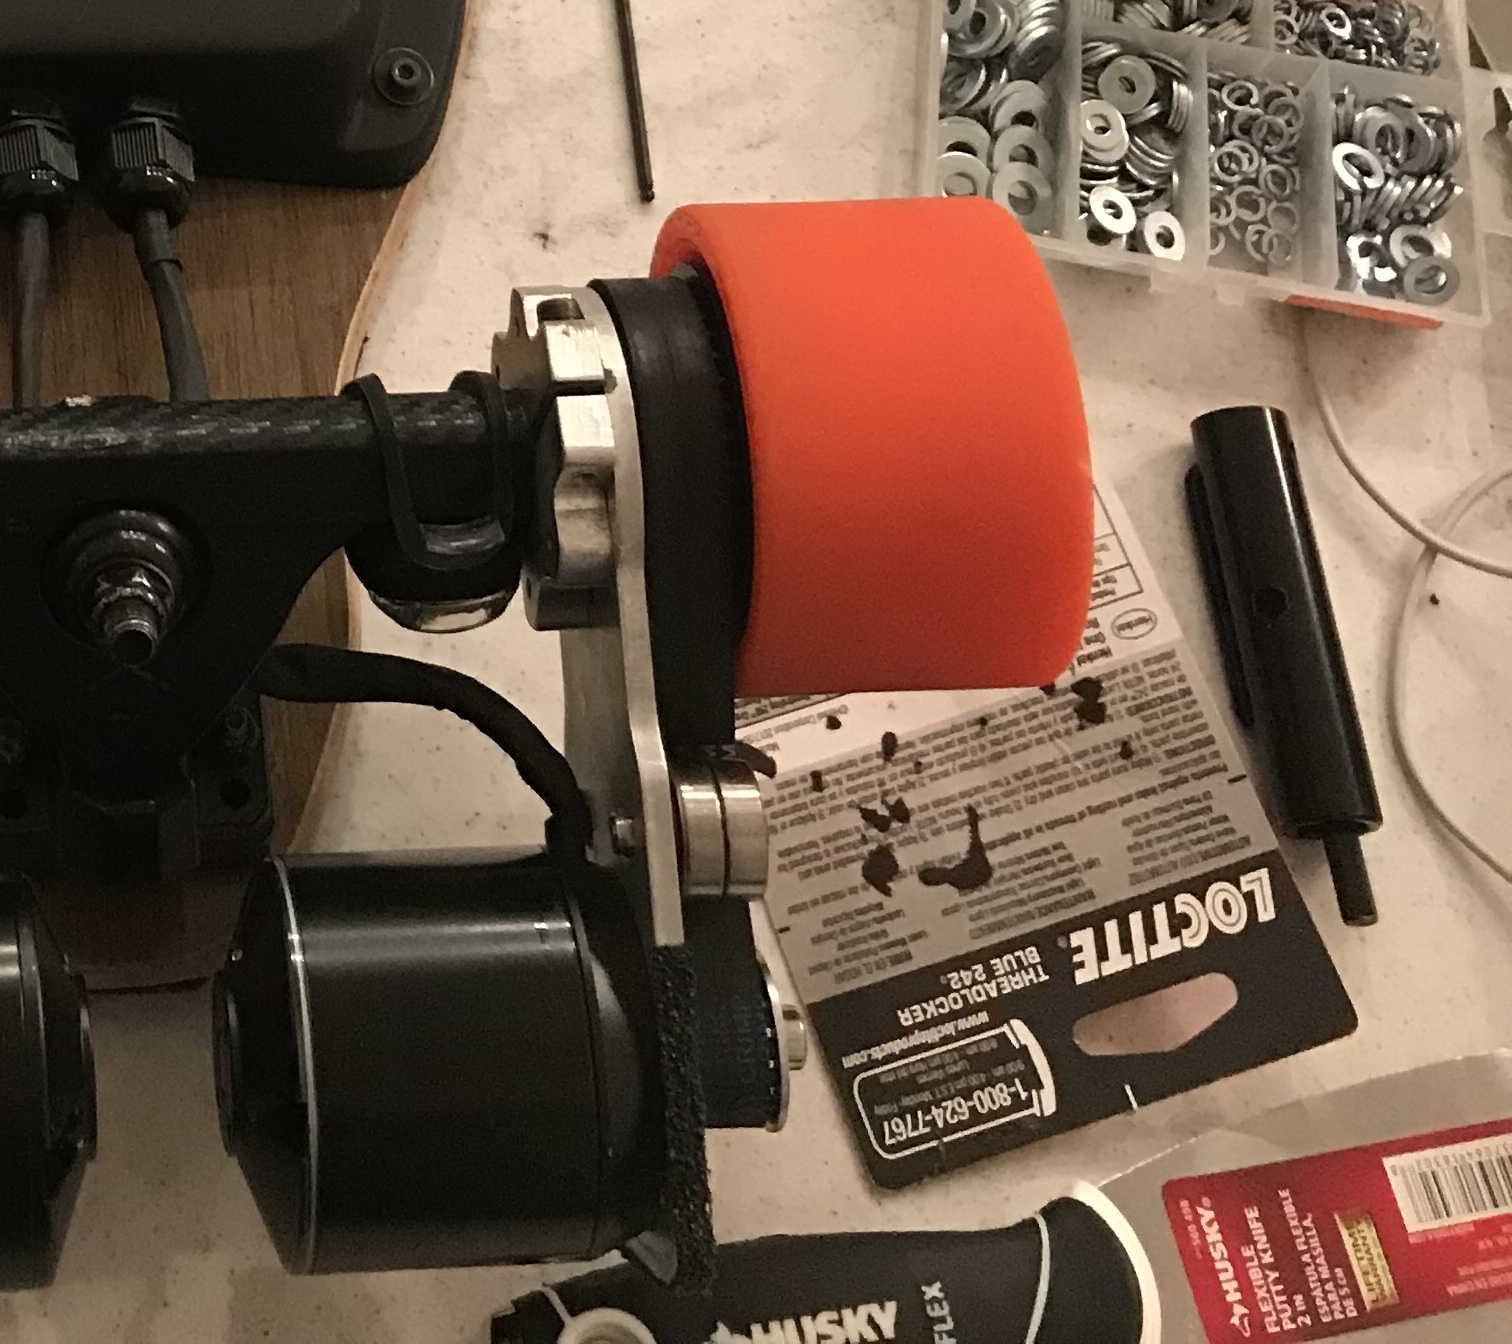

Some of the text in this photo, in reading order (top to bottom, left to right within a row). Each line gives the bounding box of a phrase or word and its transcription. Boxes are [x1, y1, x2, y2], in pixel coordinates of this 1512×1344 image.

[1068, 867, 1277, 985] LOCTITE
[989, 944, 1041, 976] BLUE
[895, 963, 1049, 1027] THREADLOCKER
[882, 1078, 1029, 1145] 1-800-624-7767
[1278, 1188, 1309, 1251] FLEXIBLE
[1196, 1206, 1242, 1302] HUSKY
[1244, 1205, 1297, 1330] PUTTY KNIFE
[921, 1281, 958, 1344] FLEX
[1241, 1244, 1281, 1333] FLEXIBLE
[1323, 1281, 1346, 1320] PARA
[750, 1300, 898, 1344] HUSKY
[1296, 1313, 1312, 1328] 2
